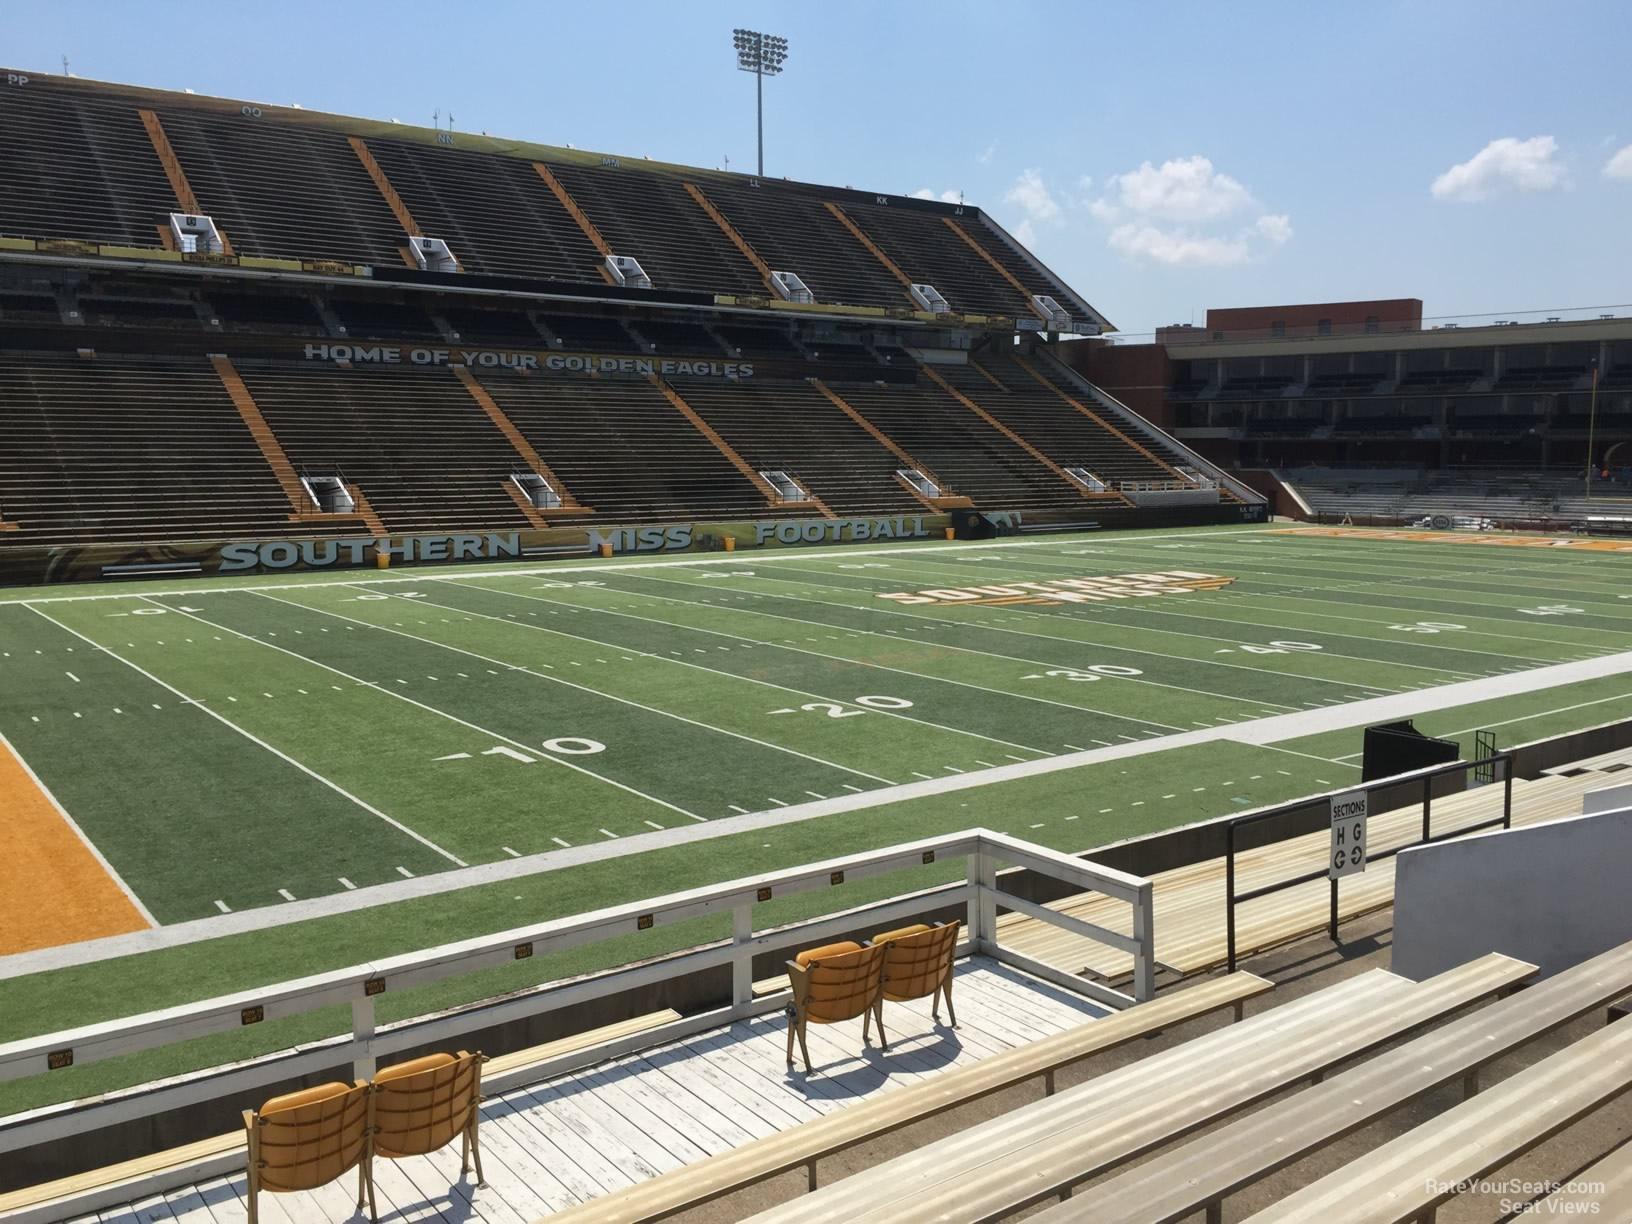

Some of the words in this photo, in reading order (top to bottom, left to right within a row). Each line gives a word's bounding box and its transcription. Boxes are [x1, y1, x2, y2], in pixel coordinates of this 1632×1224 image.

[7, 73, 29, 86] PP
[436, 133, 454, 145] NN
[602, 157, 620, 168] MM
[749, 178, 761, 188] LL
[876, 196, 888, 205] KK
[954, 207, 963, 215] JJ
[302, 343, 400, 363] HOME
[410, 348, 450, 365] OF
[459, 350, 539, 370] YOUR
[545, 355, 652, 376] GOLDEN
[660, 360, 754, 378] EAGLES
[219, 532, 523, 572] SOUTHERN
[585, 526, 694, 553] MISS
[755, 516, 930, 546] FOOTBALL
[1385, 621, 1468, 634] 50
[1239, 640, 1323, 654] 40
[1045, 664, 1143, 682] 30
[800, 695, 914, 718] 20
[480, 736, 606, 764] 10
[1333, 800, 1366, 819] SECTIONS
[1336, 827, 1345, 846] H
[1352, 822, 1362, 841] G
